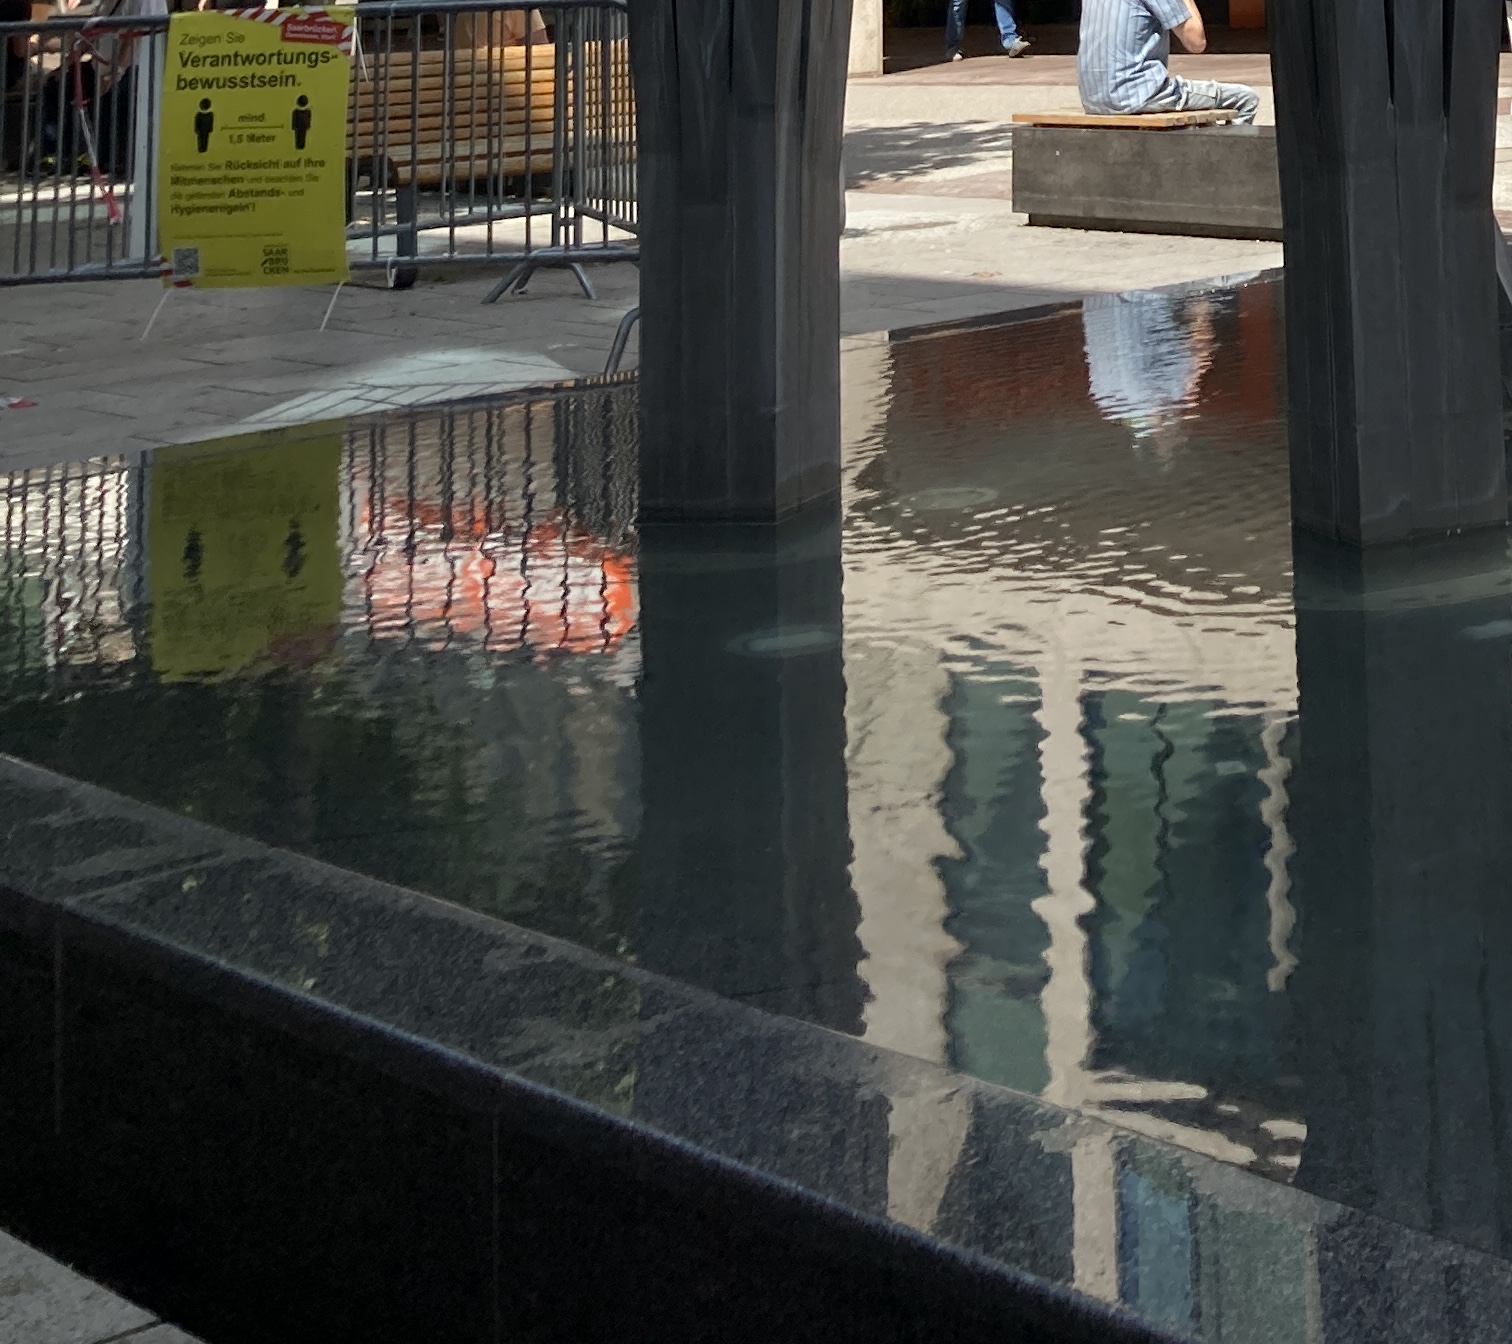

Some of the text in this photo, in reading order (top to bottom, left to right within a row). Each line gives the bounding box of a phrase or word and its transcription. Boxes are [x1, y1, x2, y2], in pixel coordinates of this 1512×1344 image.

[179, 31, 246, 48] Zeigen Sie
[178, 50, 338, 69] Verantwortungs-
[176, 70, 302, 91] bewusstsein.
[246, 133, 277, 143] Meter
[224, 158, 280, 171] Rücksicht
[283, 158, 301, 169] auf
